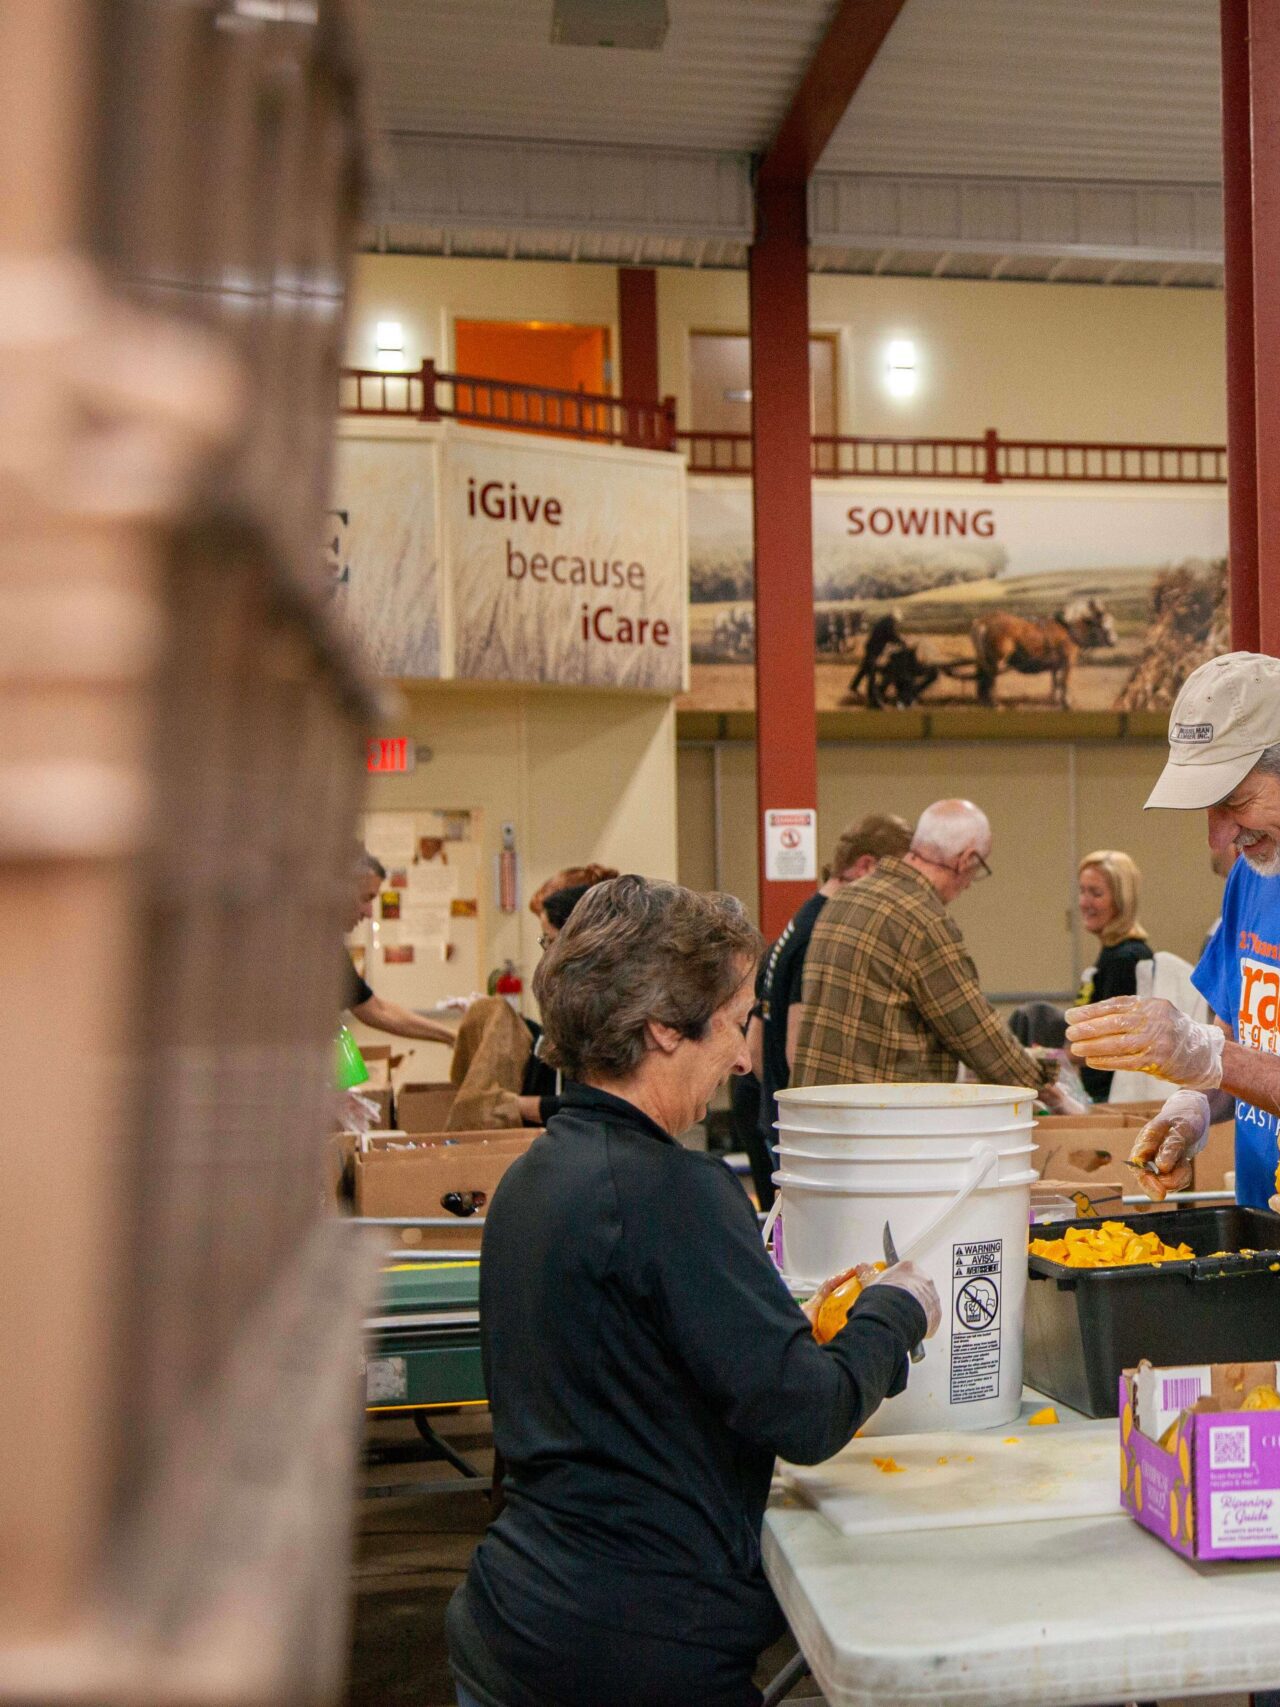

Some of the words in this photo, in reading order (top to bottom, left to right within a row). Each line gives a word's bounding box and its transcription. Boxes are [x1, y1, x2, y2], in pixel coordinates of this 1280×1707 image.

[467, 477, 563, 526] iGive
[847, 507, 995, 537] SOWING
[506, 538, 646, 590] because
[581, 603, 670, 647] iCare
[964, 1243, 1001, 1255] WARNING
[972, 1253, 995, 1265] AVISO
[1220, 1496, 1273, 1511] Ripening
[1234, 1508, 1269, 1525] Guide
